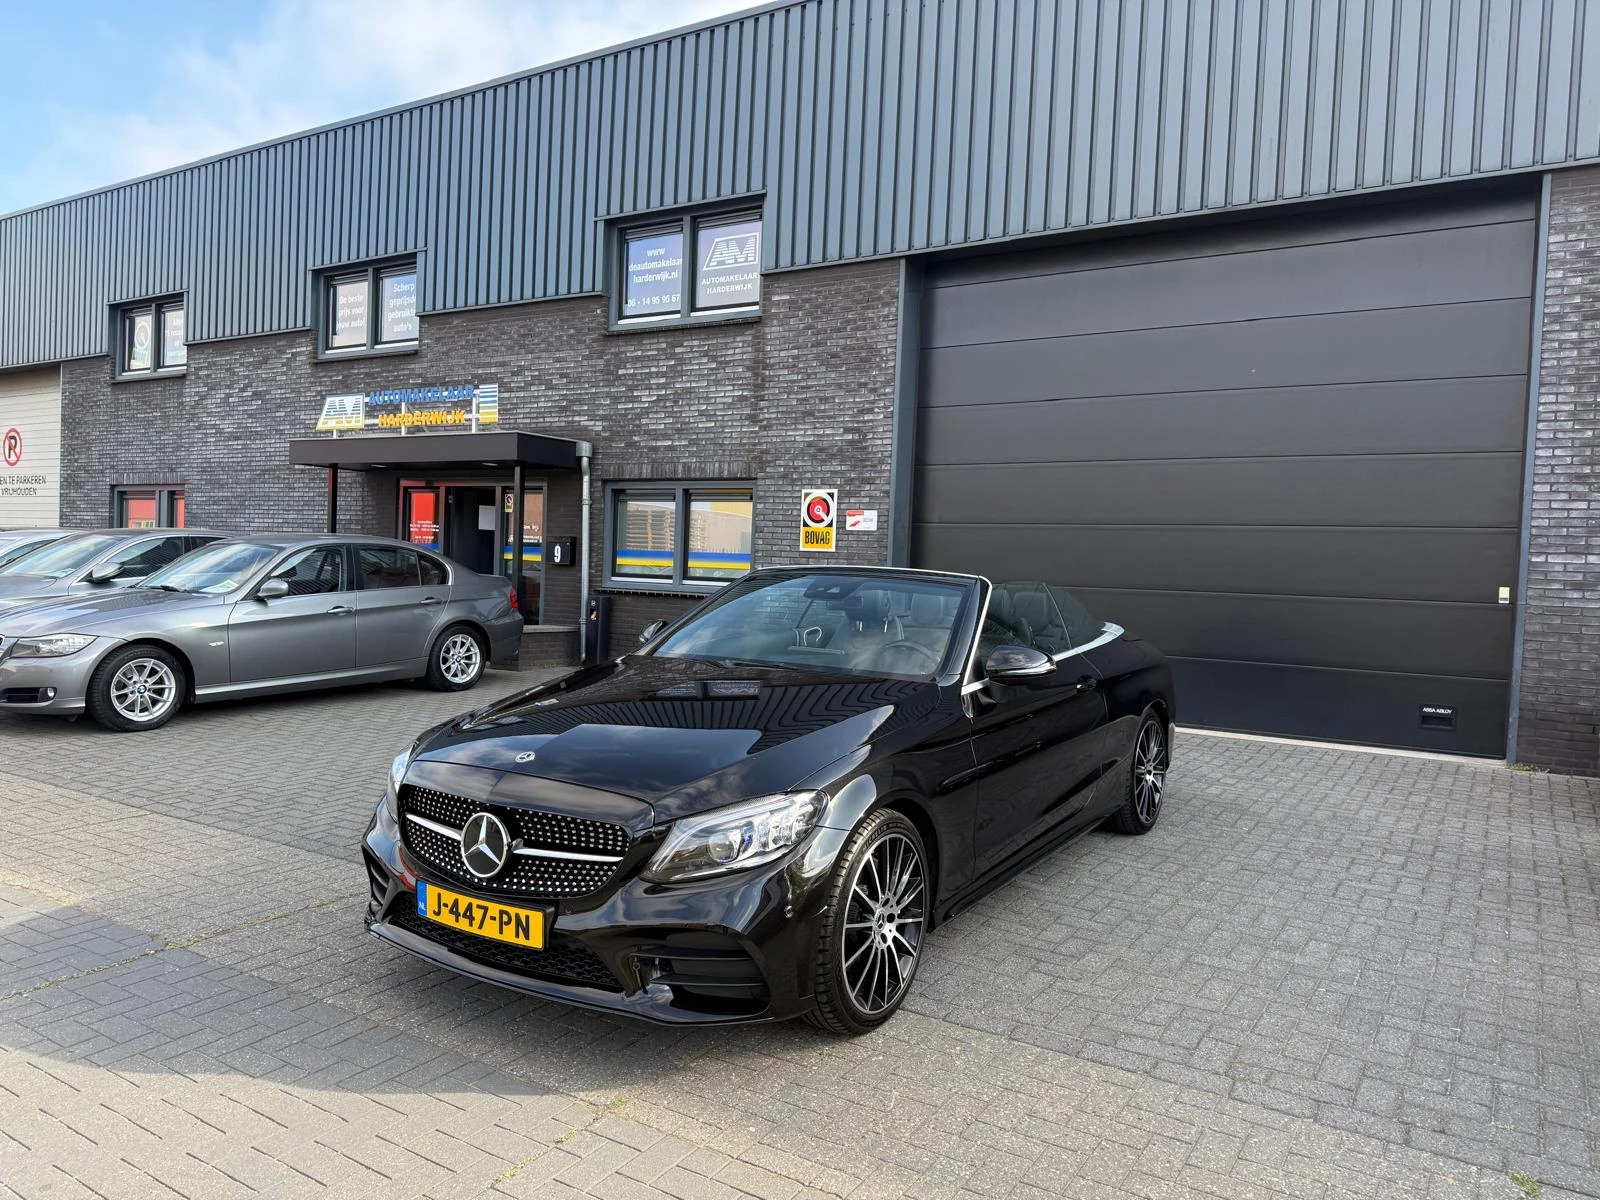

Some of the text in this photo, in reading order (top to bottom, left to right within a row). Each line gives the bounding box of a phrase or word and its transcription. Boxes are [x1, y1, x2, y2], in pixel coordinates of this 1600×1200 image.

[646, 248, 666, 256] www
[633, 270, 678, 284] harderwijk.nl
[701, 272, 758, 285] AUTOMAKELAAR
[393, 283, 415, 293] Scherp
[706, 283, 753, 295] HARDERWIJK
[628, 298, 636, 307] 06
[642, 297, 650, 306] 14
[651, 295, 660, 305] 95
[661, 294, 670, 304] 95
[671, 293, 680, 303] 67
[351, 306, 364, 315] voor
[368, 384, 475, 406] AUTOMAKELAAR
[378, 409, 466, 428] HARDERWIJK
[8, 475, 16, 485] TE
[16, 475, 46, 484] PARKEREN
[804, 530, 831, 545] BOVAG
[554, 545, 562, 562] 9
[432, 892, 531, 941] J-447-PN
